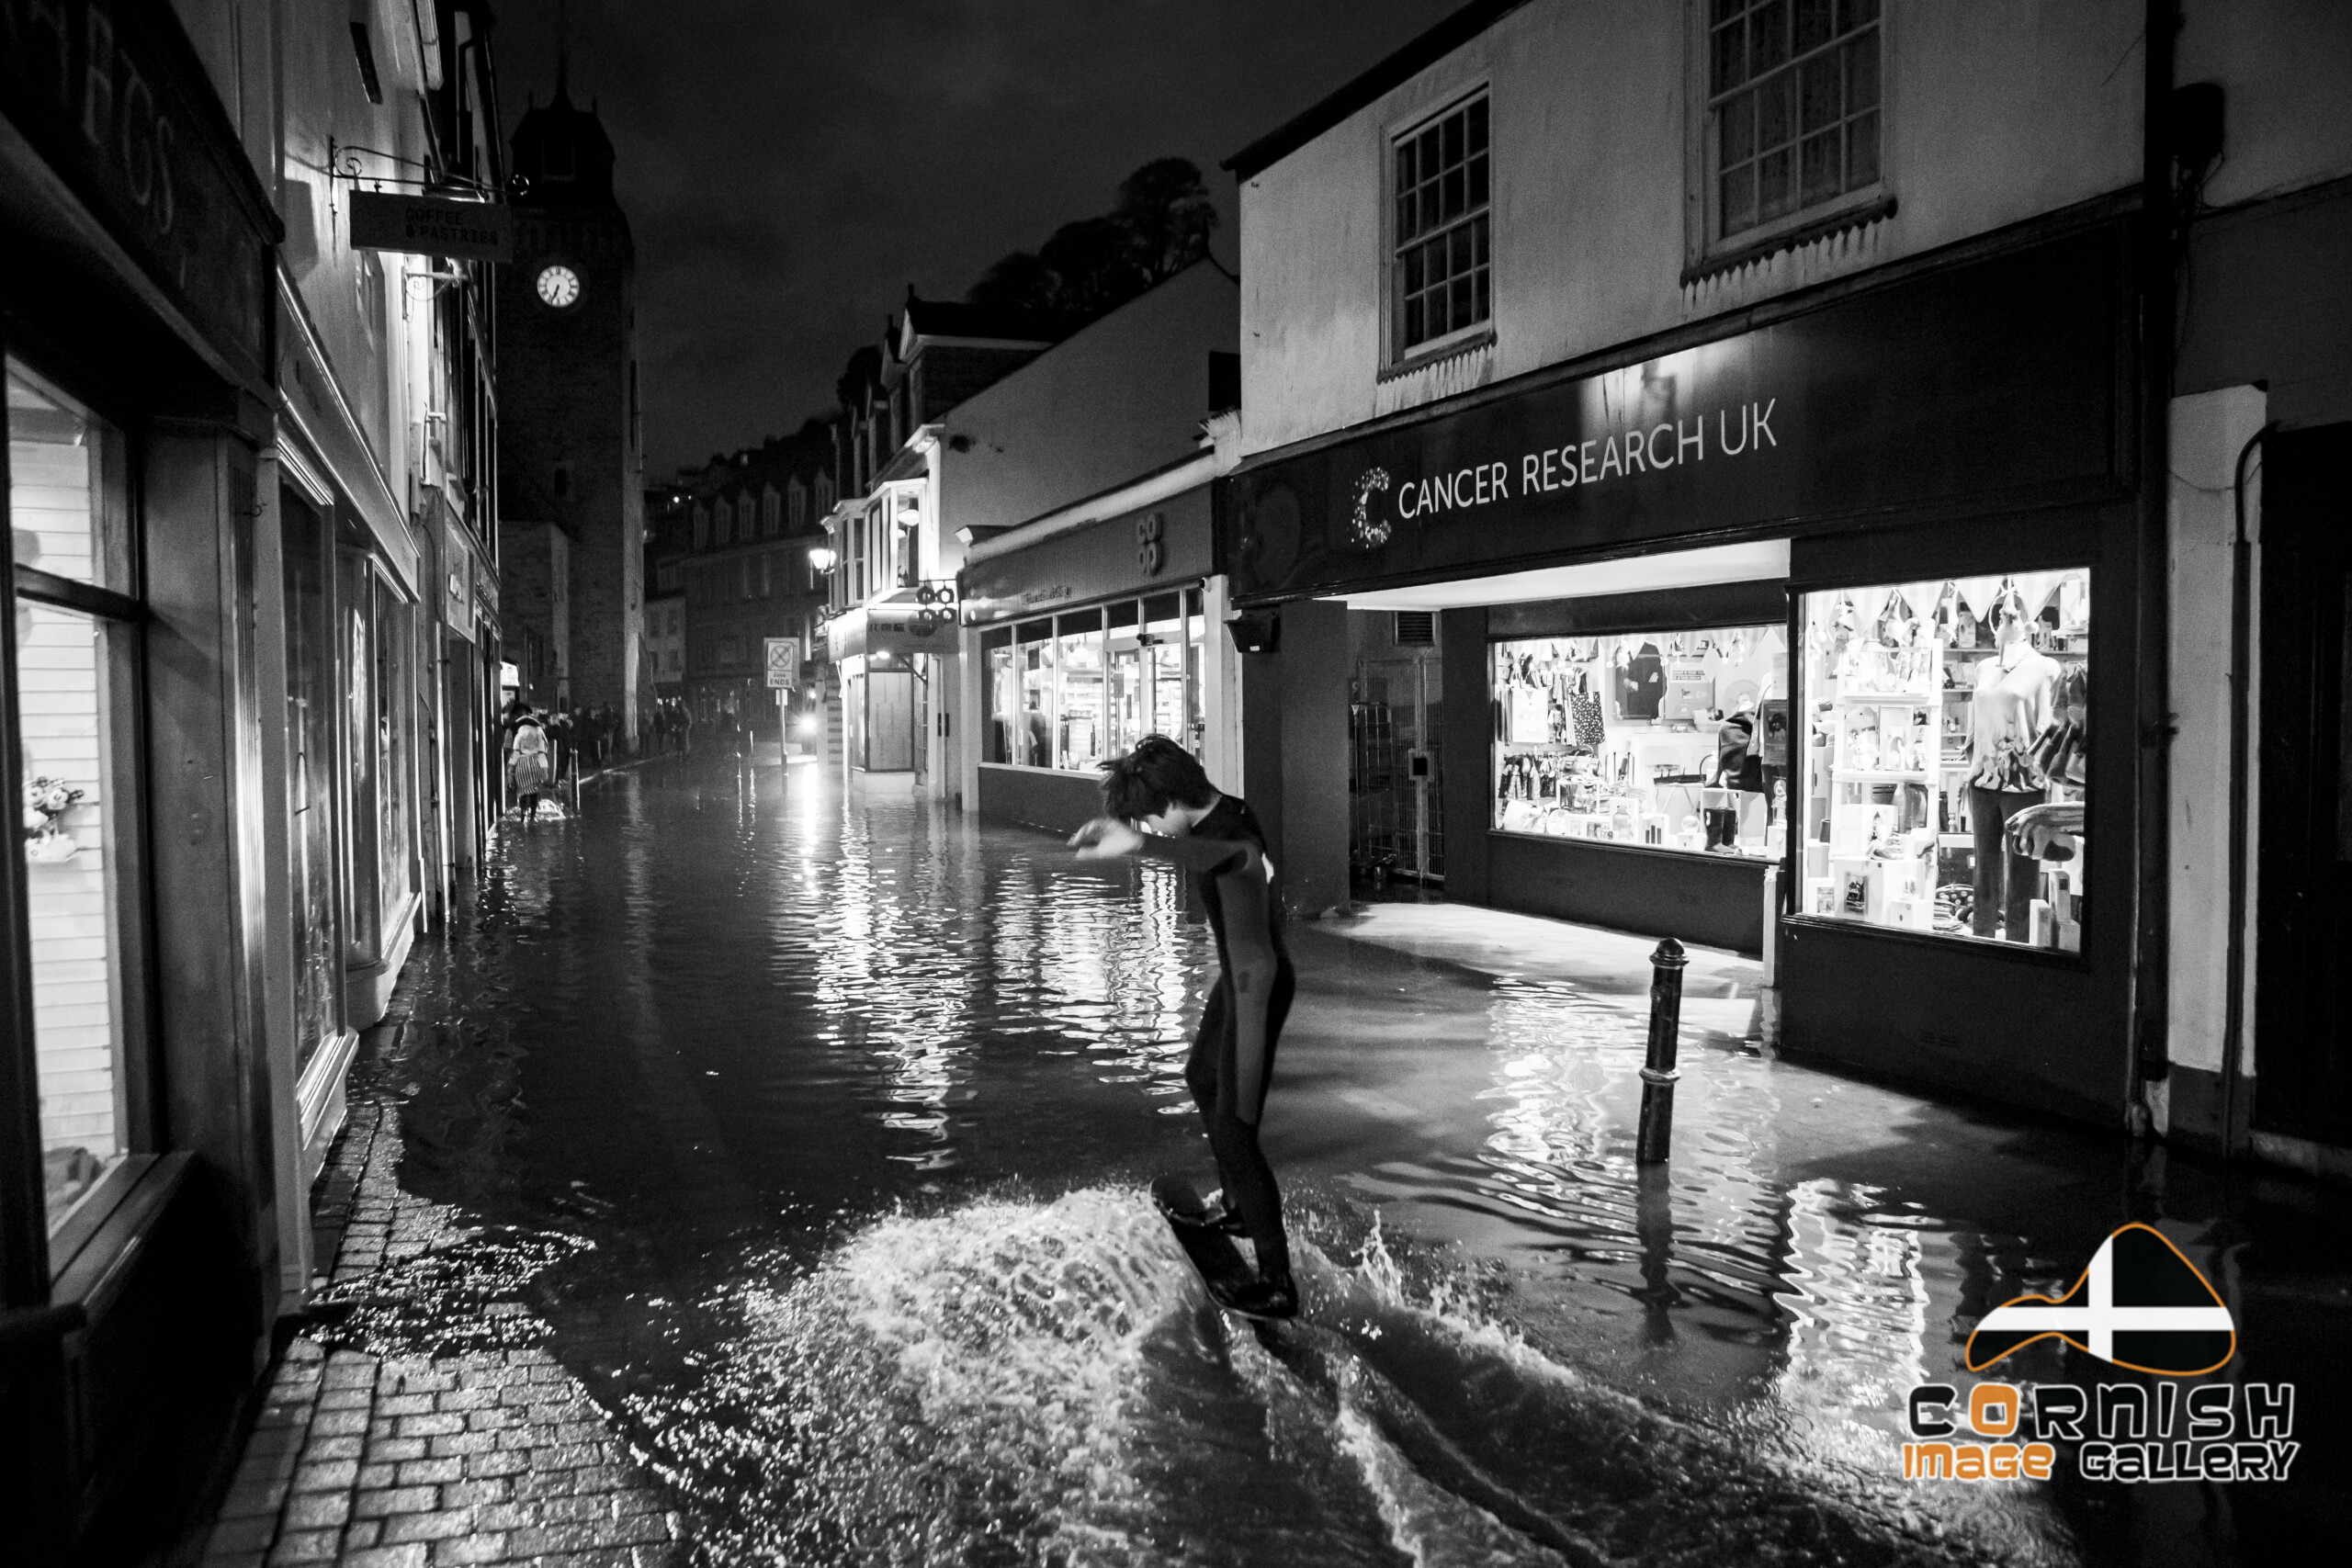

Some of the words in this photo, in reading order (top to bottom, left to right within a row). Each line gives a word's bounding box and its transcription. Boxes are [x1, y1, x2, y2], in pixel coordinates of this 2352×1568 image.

[405, 206, 463, 226] COFFEE
[420, 225, 497, 245] PASTRIES
[1398, 461, 1509, 519] CANCER
[1522, 415, 1704, 496] RESEARCH
[1720, 398, 1778, 456] UK
